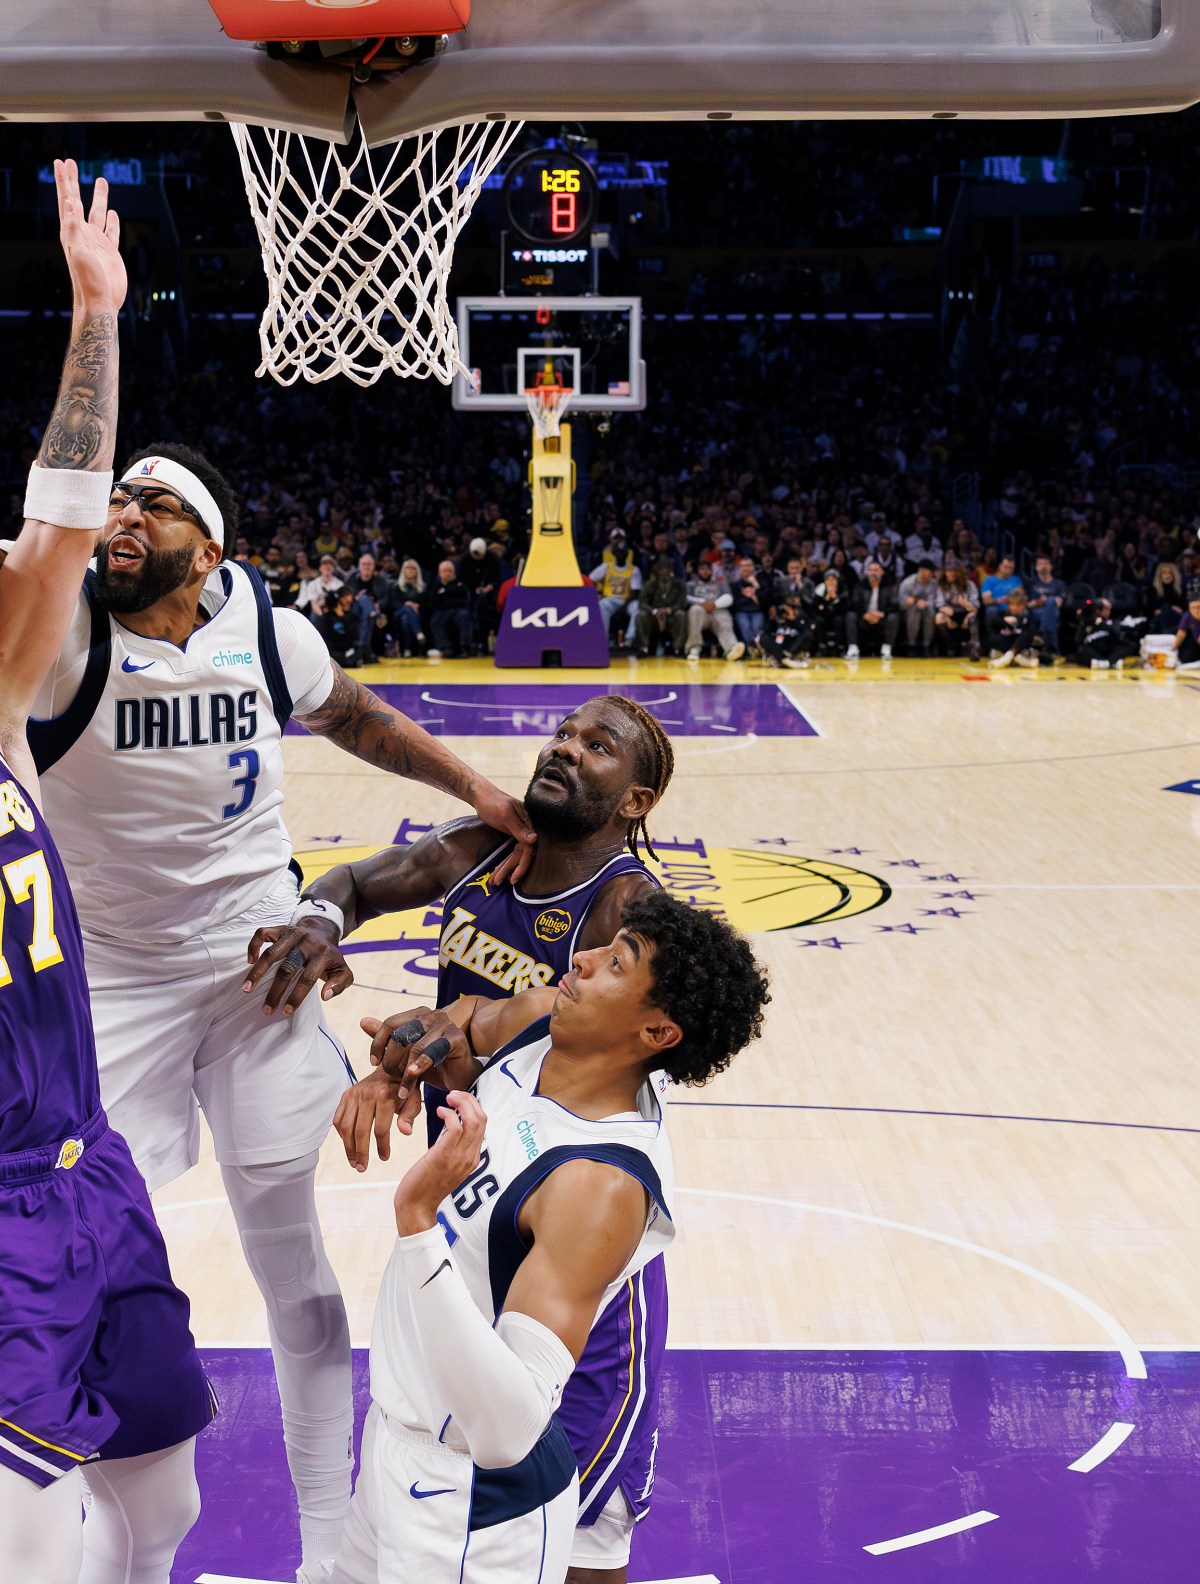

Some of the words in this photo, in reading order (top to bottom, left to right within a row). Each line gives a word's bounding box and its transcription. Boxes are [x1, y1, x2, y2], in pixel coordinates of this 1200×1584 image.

[541, 169, 580, 192] 1:26
[552, 193, 576, 233] 8
[533, 250, 588, 262] TISSOT
[511, 606, 589, 629] KIA
[212, 650, 253, 669] chime
[114, 689, 258, 751] DALLAS
[222, 749, 260, 821] 3
[539, 914, 569, 933] bibigo
[438, 906, 555, 995] LAKERS
[516, 1120, 539, 1160] chime
